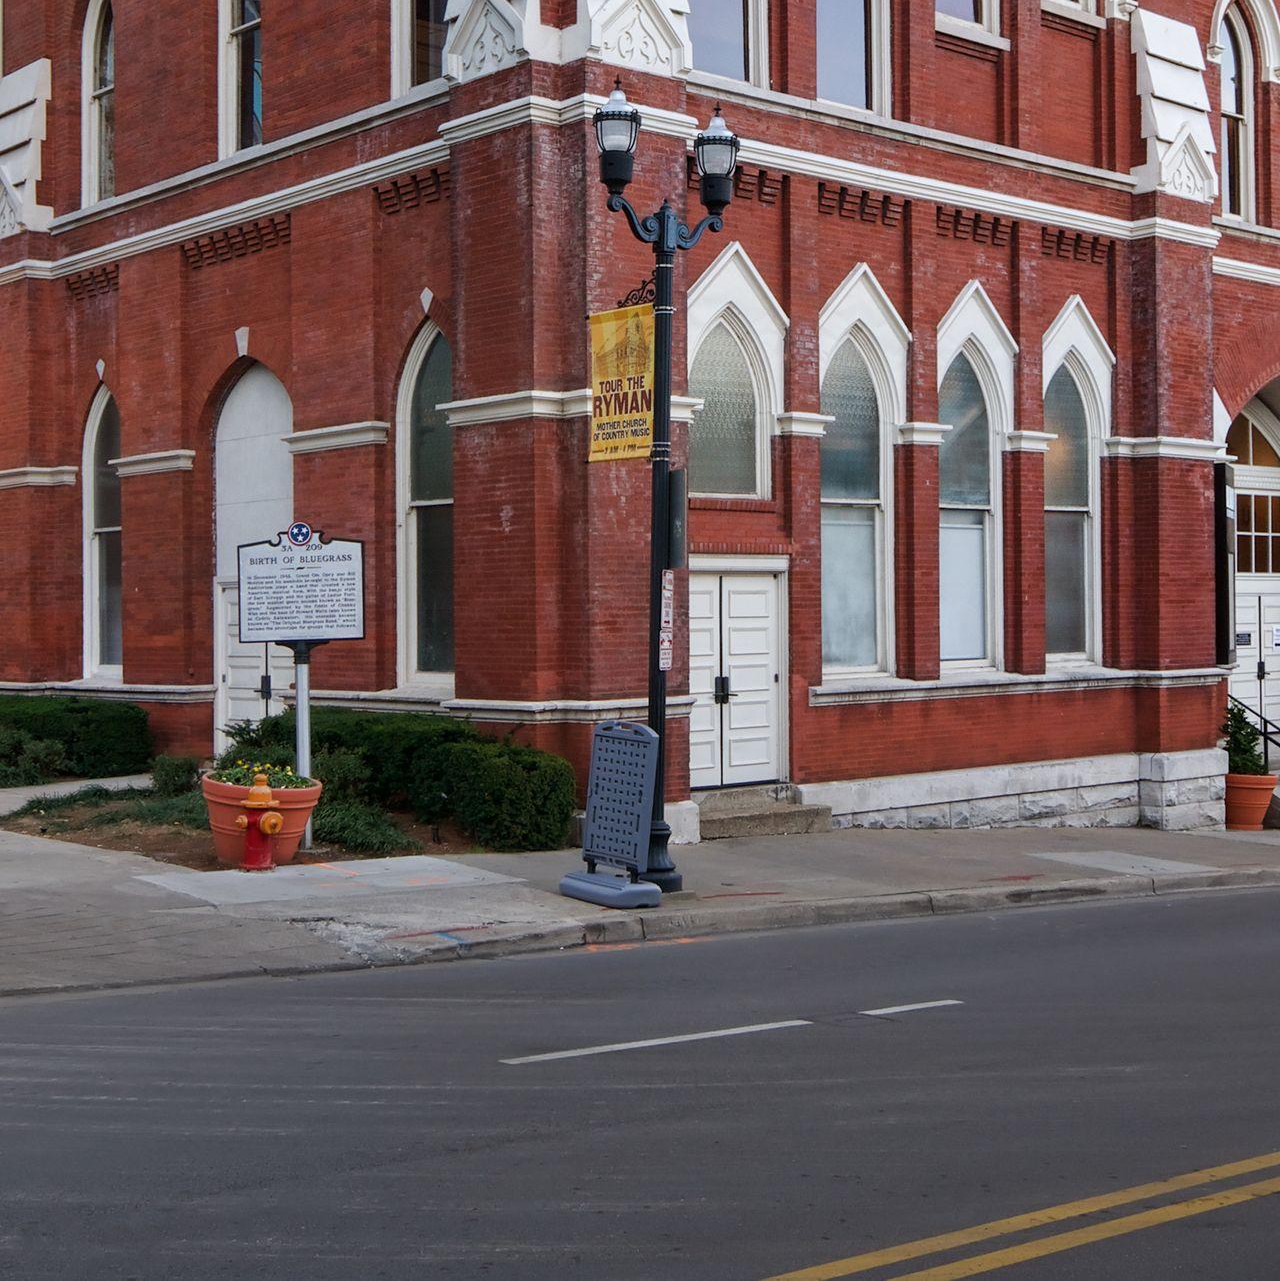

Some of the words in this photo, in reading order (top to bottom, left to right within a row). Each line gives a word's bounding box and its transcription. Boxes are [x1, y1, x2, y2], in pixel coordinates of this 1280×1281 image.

[599, 379, 623, 394] TOUR
[627, 375, 645, 391] THE
[593, 389, 652, 418] RYMAN
[597, 421, 620, 431] MOTHER
[623, 418, 647, 429] CHURCH
[593, 433, 600, 441] OF
[602, 430, 628, 440] COUNTRY
[631, 427, 650, 438] MUSIC
[609, 446, 619, 454] AM
[300, 554, 352, 563] BLUEGRASS
